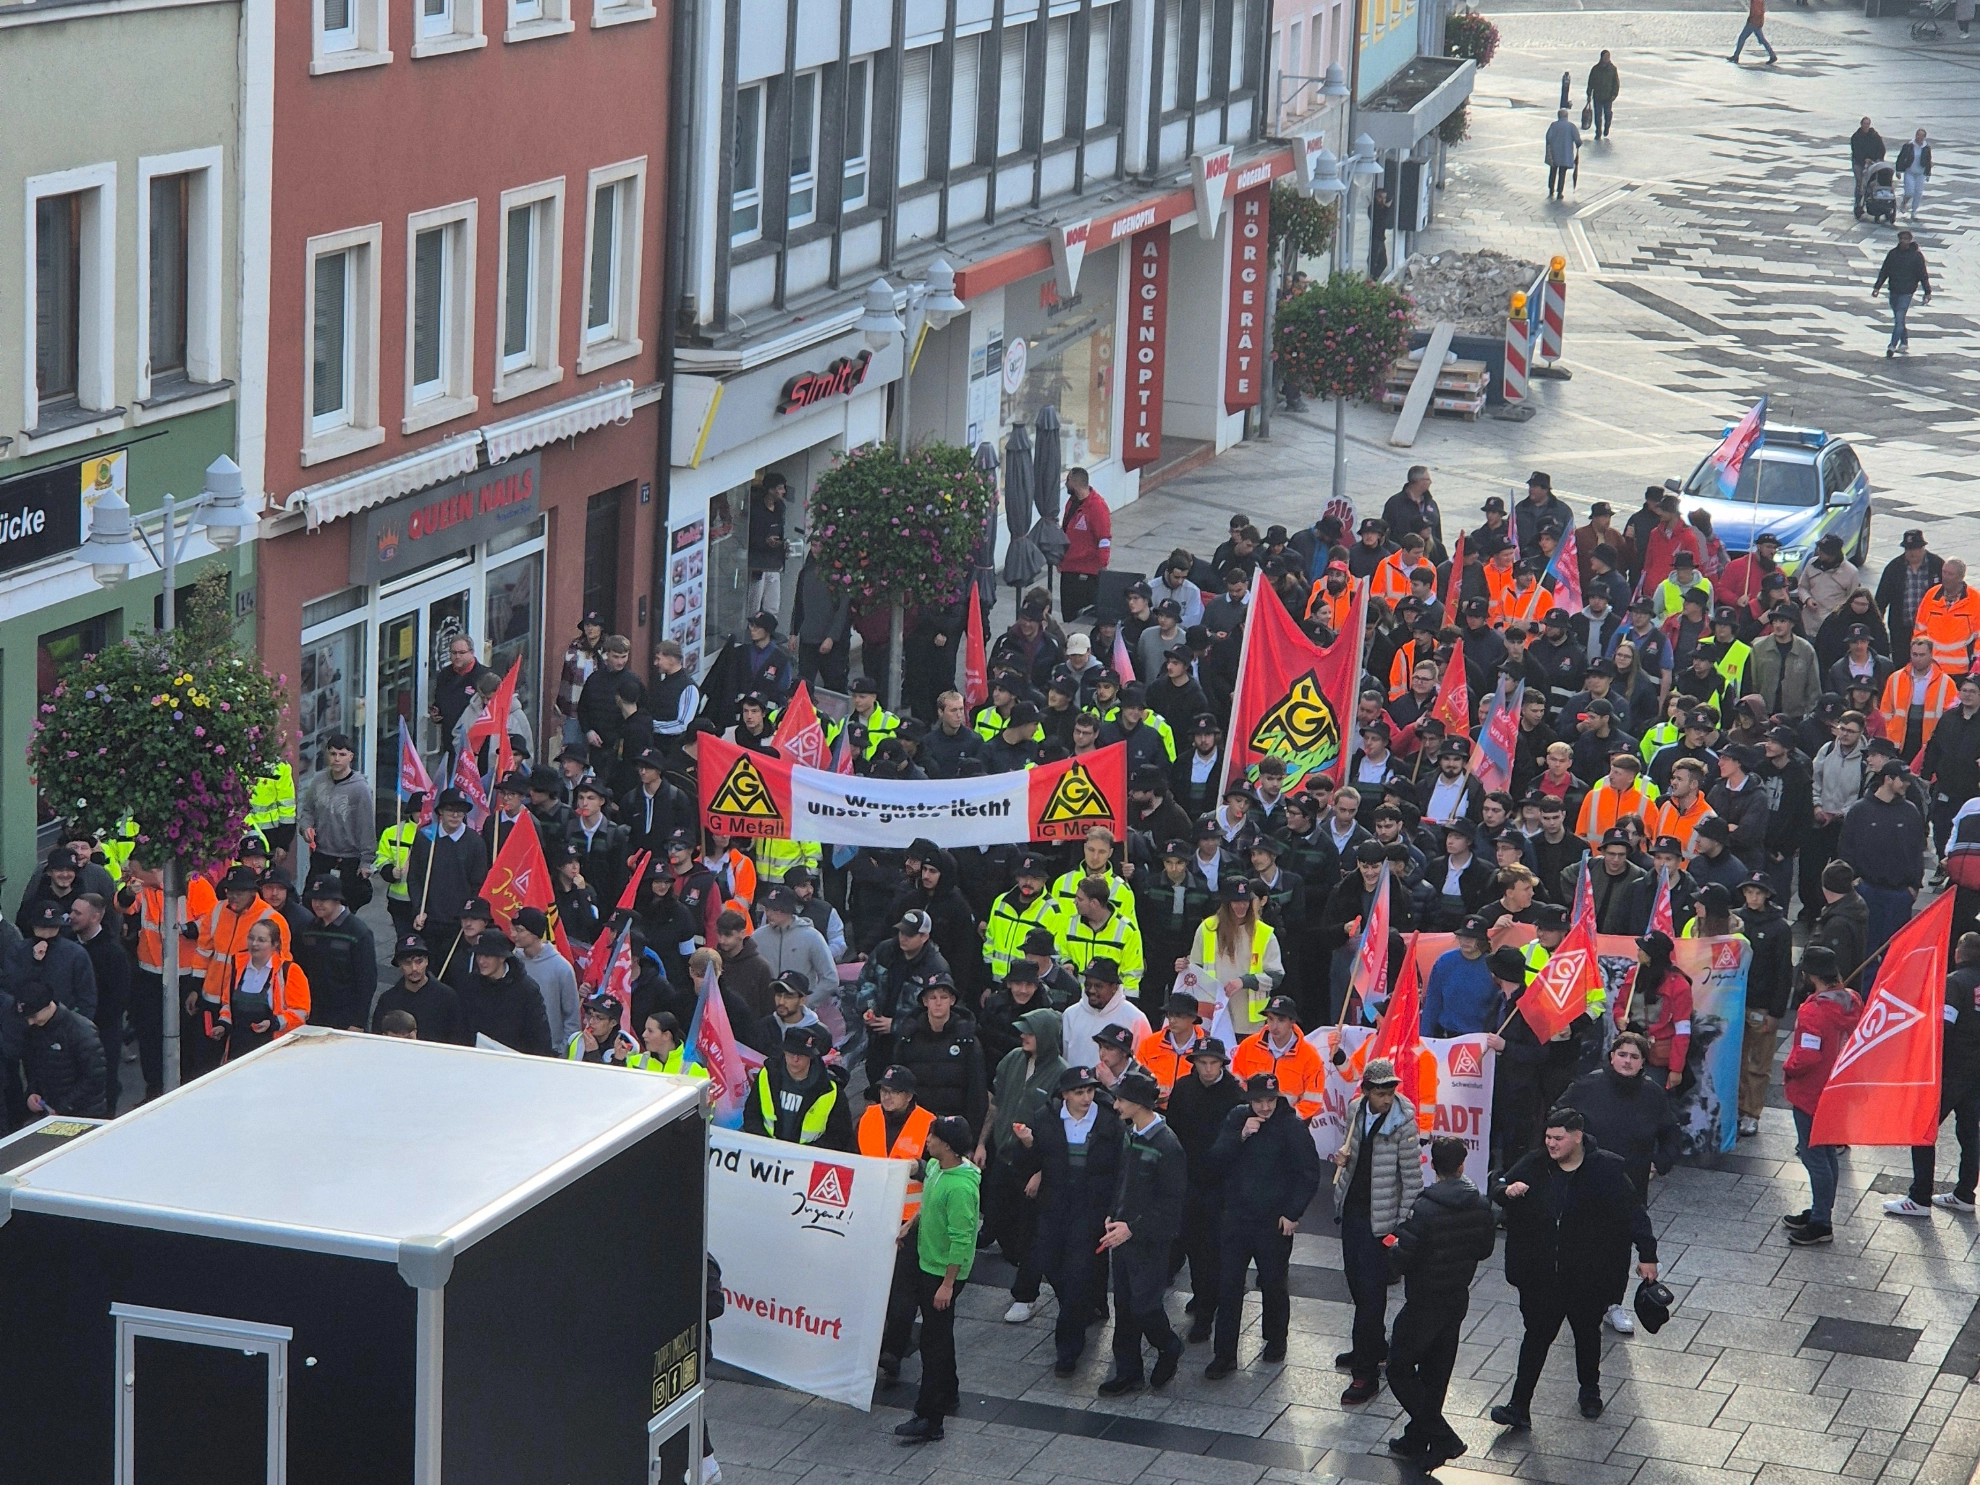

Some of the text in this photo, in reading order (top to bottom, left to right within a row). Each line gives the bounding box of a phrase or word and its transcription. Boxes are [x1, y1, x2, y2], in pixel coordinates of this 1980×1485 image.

[1111, 207, 1156, 239] AUGENOPTIK
[1238, 201, 1259, 393] HÖRGERÄTE
[1135, 241, 1158, 448] AUGENOPTIK
[408, 468, 533, 540] QUEEN NAILS
[0, 506, 45, 544] ücke
[729, 817, 784, 837] Metall
[1036, 824, 1057, 837] IG
[1433, 1104, 1484, 1135] ADT
[709, 1147, 795, 1186] nd wir
